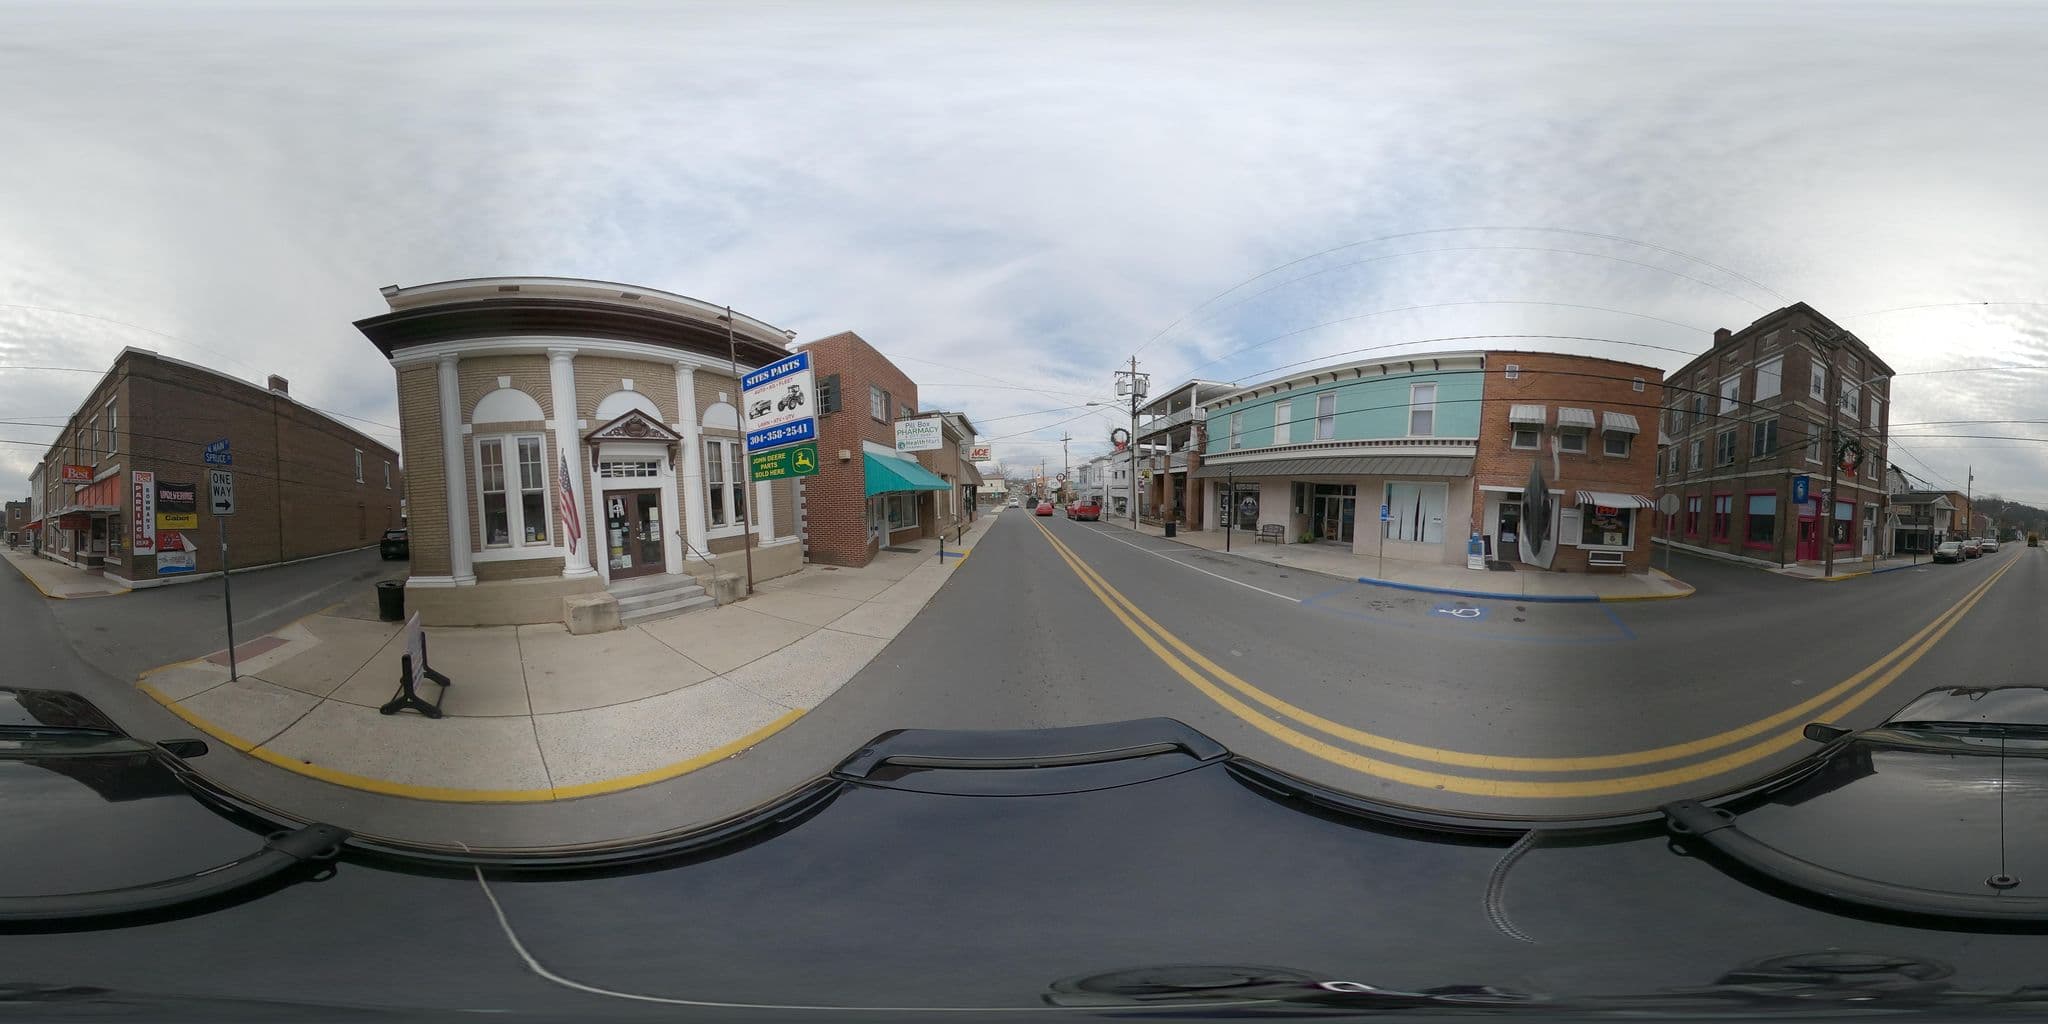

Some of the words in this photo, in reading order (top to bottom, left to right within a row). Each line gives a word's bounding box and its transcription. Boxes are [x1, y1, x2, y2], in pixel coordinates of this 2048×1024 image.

[746, 371, 769, 387] SITES
[771, 359, 801, 377] PARTS
[749, 423, 808, 446] 304-358-2541
[897, 426, 939, 436] PHARMACY
[205, 453, 226, 463] SPRUCE
[752, 455, 767, 464] JOHN
[767, 452, 786, 462] DEERE
[971, 448, 990, 457] ACE
[760, 462, 778, 470] PARTS
[68, 468, 89, 480] Best
[755, 469, 769, 478] SOLD
[769, 467, 785, 476] HERE
[212, 472, 231, 485] ONE
[159, 490, 194, 501] WOLVERINE
[213, 486, 232, 497] WAY
[135, 485, 143, 532] PARKING
